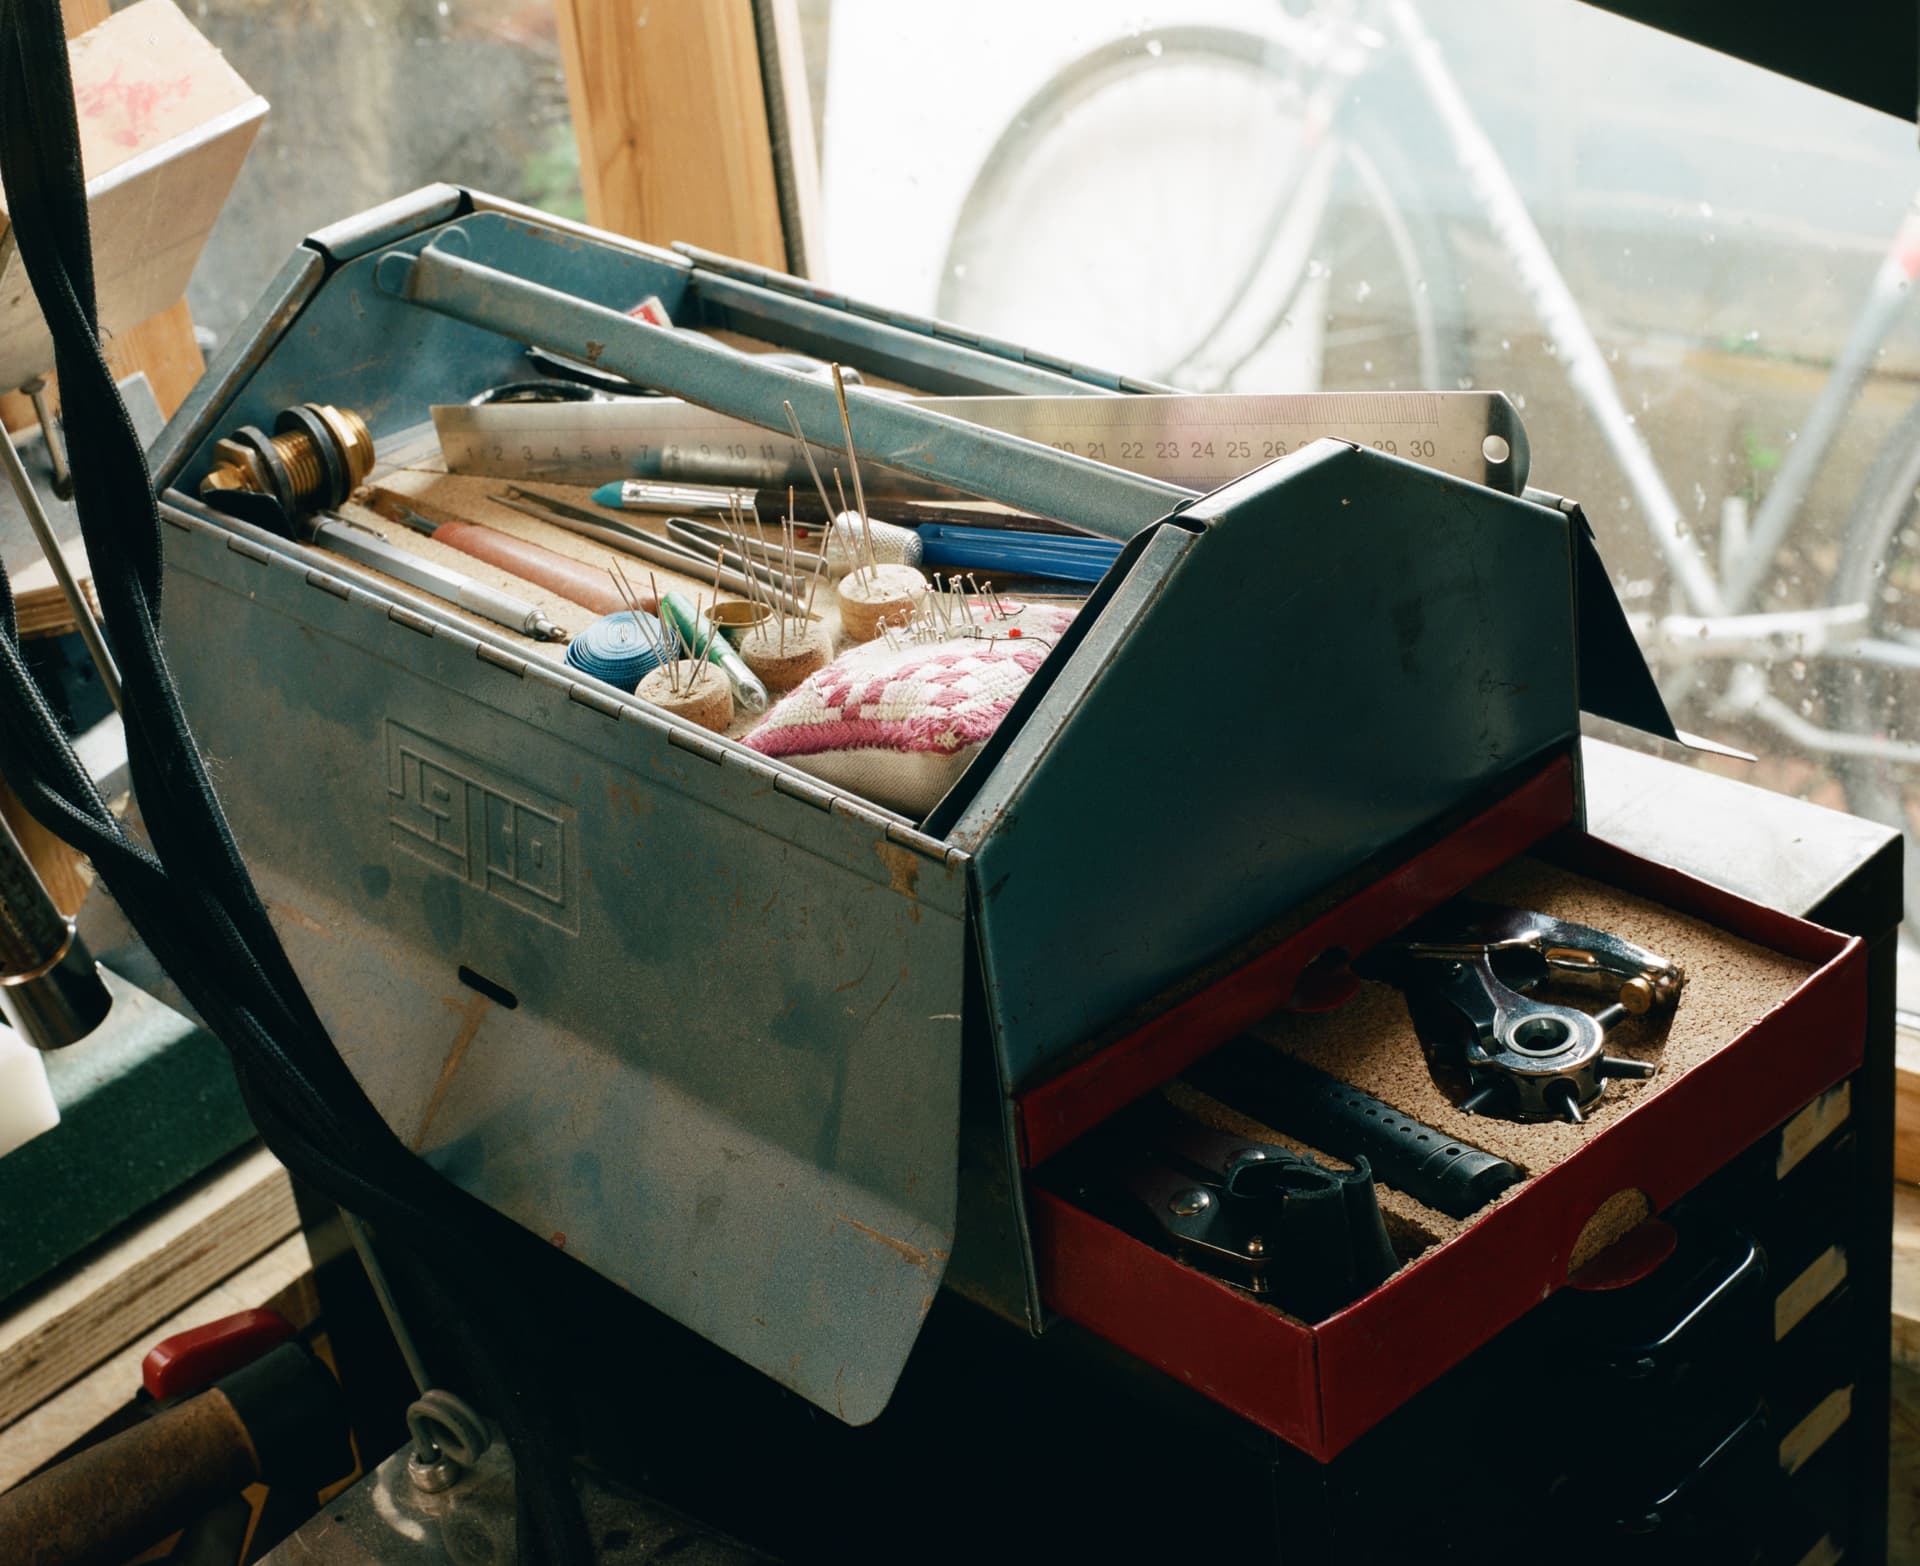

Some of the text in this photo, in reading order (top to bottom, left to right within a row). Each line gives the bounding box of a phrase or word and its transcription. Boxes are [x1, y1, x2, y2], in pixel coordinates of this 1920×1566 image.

[494, 446, 504, 461] 2
[522, 445, 533, 461] 3
[551, 446, 561, 461] 4
[581, 445, 592, 461] 5
[640, 444, 648, 460] 7
[699, 444, 710, 459] 9
[727, 443, 745, 460] 10
[759, 443, 775, 460] 11
[1087, 442, 1106, 459] 21
[1119, 441, 1144, 459] 22
[1155, 441, 1179, 459] 23
[1190, 441, 1216, 459] 24
[1225, 441, 1251, 459] 25
[1261, 441, 1287, 458] 26
[1409, 440, 1435, 458] 30
